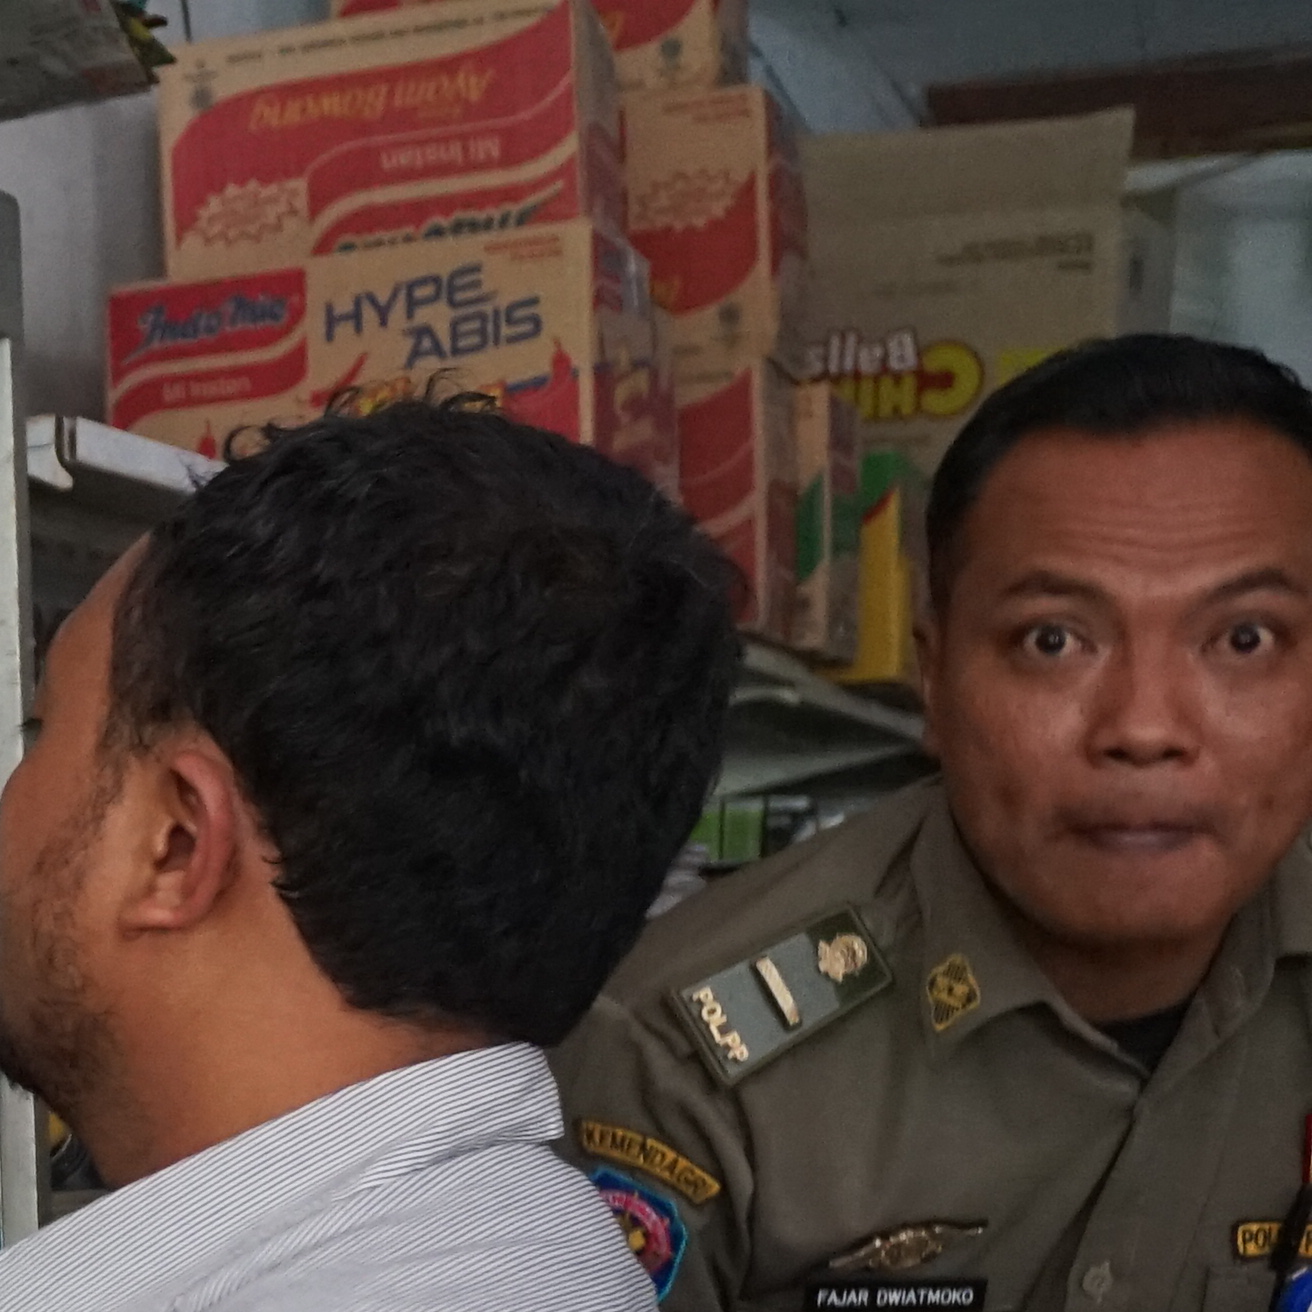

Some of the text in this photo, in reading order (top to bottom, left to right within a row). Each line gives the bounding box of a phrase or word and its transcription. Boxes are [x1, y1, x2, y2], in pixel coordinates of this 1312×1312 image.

[326, 261, 498, 343] HYPE
[402, 295, 544, 370] ABIS
[582, 1122, 712, 1198] KEMENDAGRI
[816, 1286, 975, 1308] FAJAR DWIATMOKO
